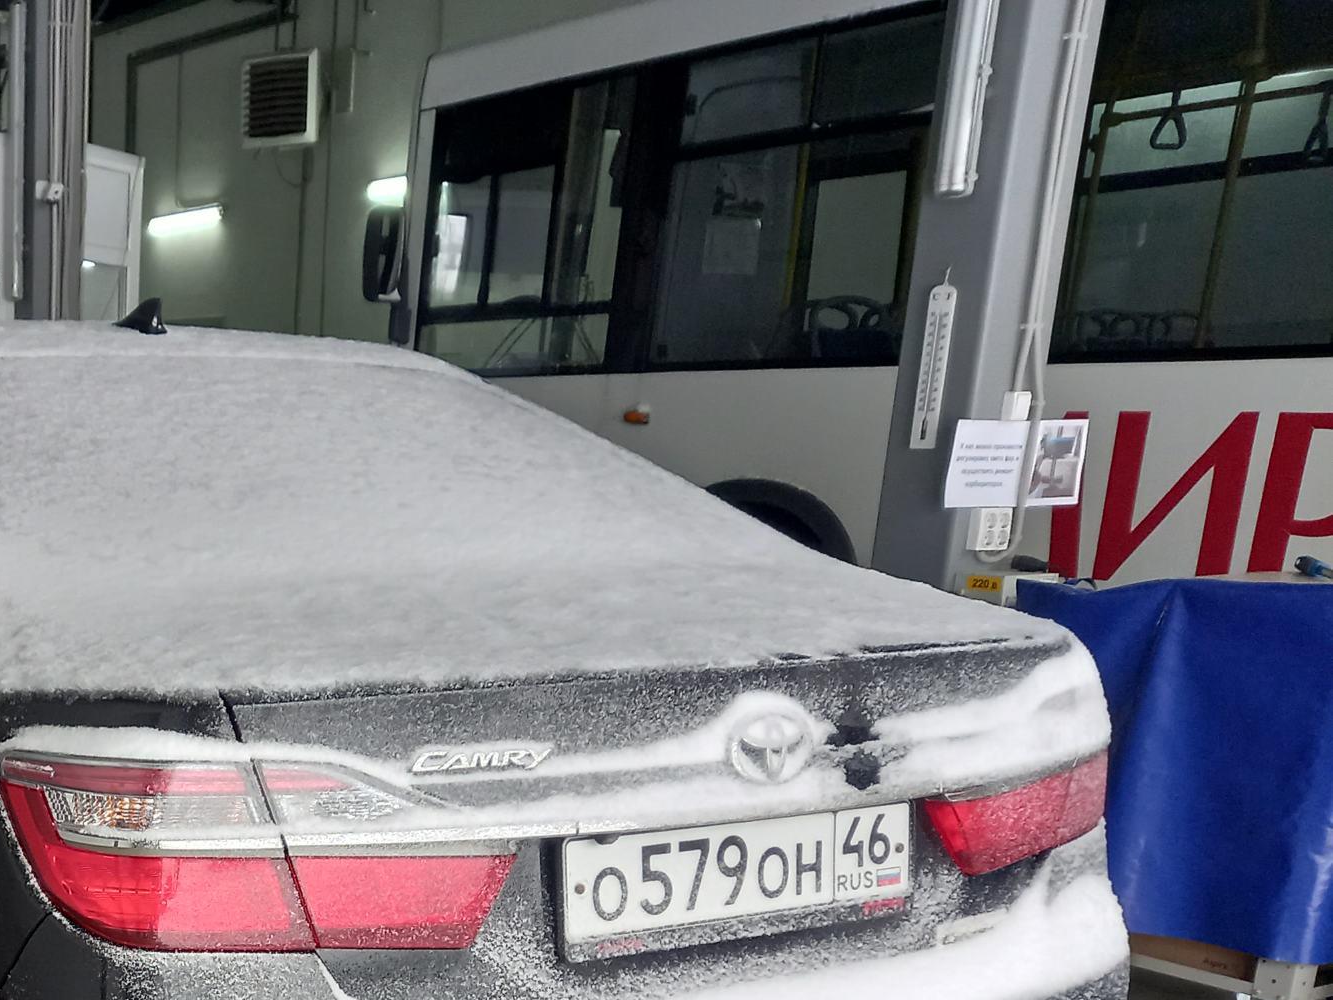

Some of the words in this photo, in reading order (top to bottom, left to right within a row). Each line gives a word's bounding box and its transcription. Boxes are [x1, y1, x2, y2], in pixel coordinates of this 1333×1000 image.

[1047, 410, 1333, 580] ИР
[971, 579, 989, 588] 220
[412, 748, 552, 773] CAMRY
[593, 835, 823, 921] О579ОН
[842, 813, 891, 868] 46
[837, 871, 874, 892] RUS
